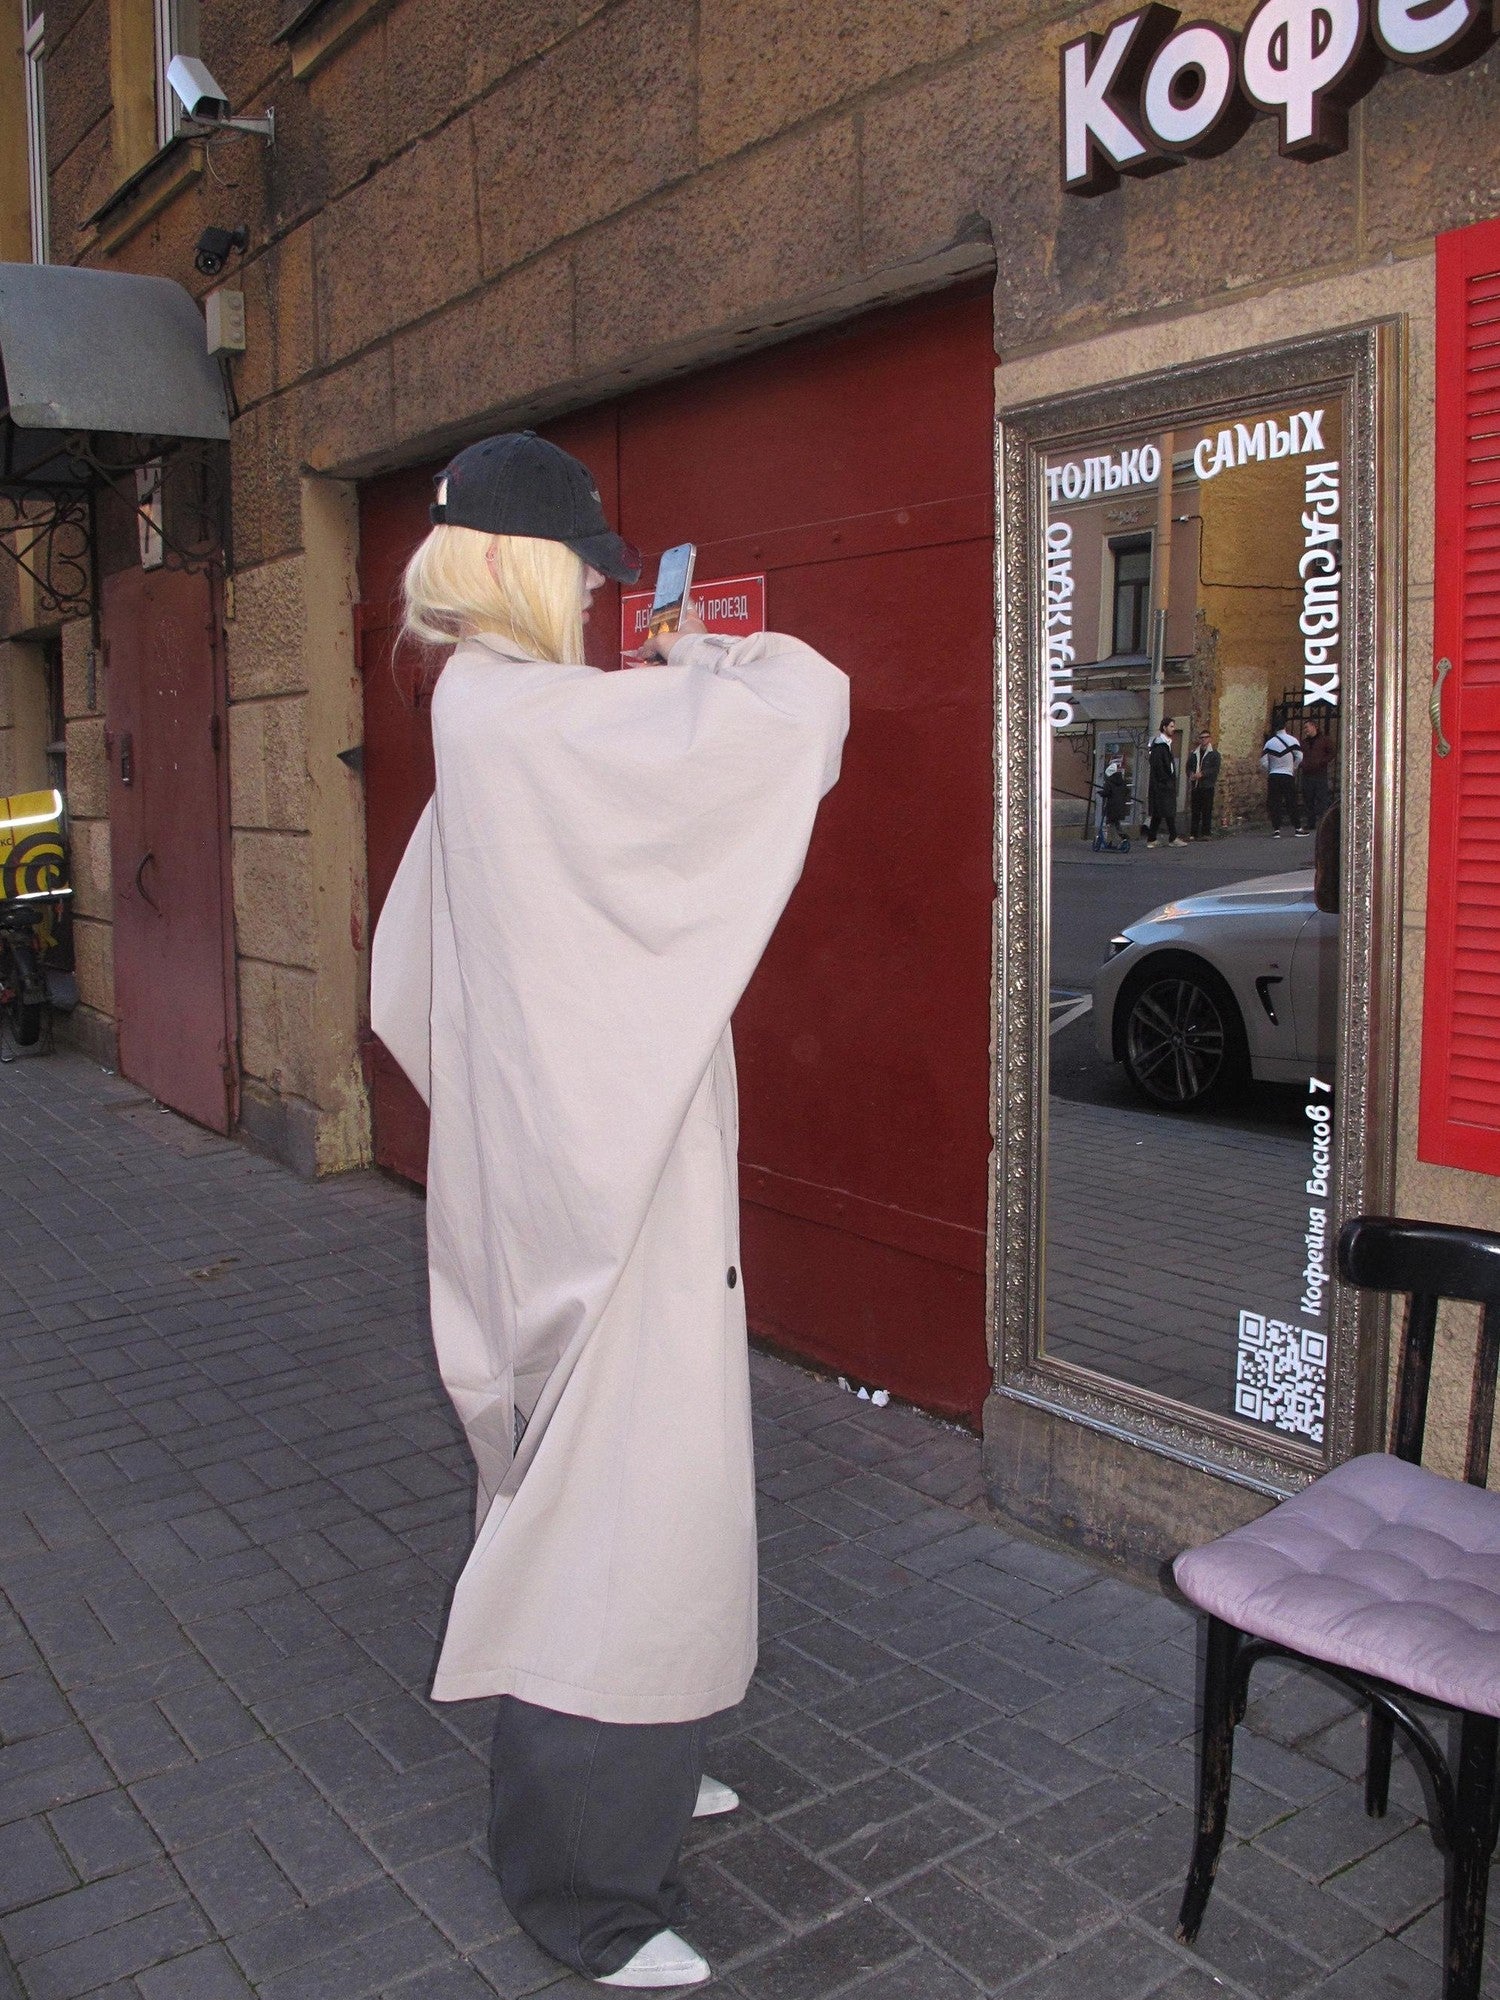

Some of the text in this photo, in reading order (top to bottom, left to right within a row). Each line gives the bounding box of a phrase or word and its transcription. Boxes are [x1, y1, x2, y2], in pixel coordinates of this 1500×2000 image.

[1045, 409, 1326, 502] ТОЛЬКО САМЫХ
[707, 595, 749, 621] ПРОЕЗД
[1045, 521, 1075, 728] ОТРАЖАЮ
[1299, 461, 1341, 707] КРАСИВЫХ
[1300, 1076, 1332, 1317] Кофейня Басков 7
